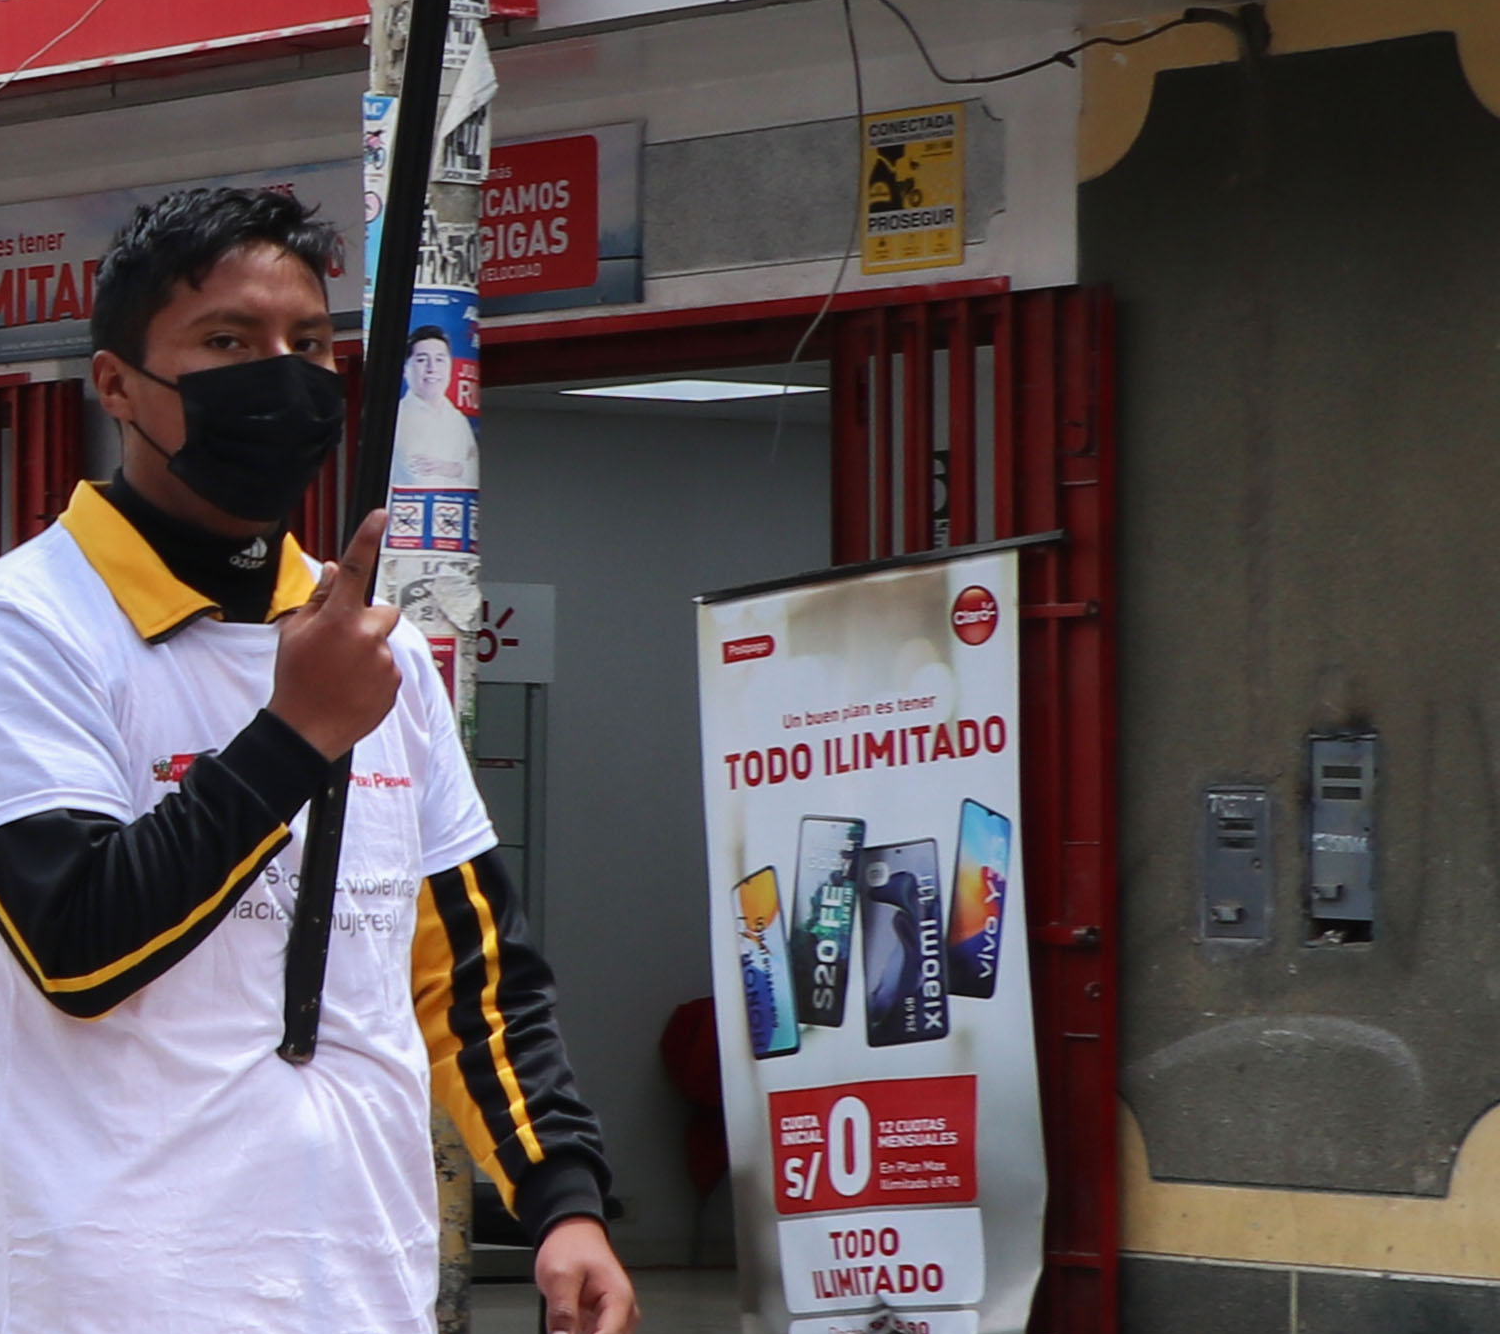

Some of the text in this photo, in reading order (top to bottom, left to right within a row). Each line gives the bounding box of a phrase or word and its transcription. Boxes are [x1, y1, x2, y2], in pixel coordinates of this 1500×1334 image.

[868, 115, 954, 138] CONECTADA
[868, 208, 955, 232] PROSEGUR
[19, 230, 65, 255] tener
[480, 217, 569, 262] GIGAS
[953, 605, 991, 627] Claro
[782, 694, 937, 730] Un buen plan es tener
[724, 715, 1008, 790] TODO ILIMITADO
[813, 885, 842, 1010] S20 FE
[976, 916, 999, 979] vivo
[877, 1131, 959, 1148] MENSUALES
[878, 1117, 947, 1133] 12 CUOTAS
[828, 1095, 872, 1196] 0
[784, 1152, 823, 1201] S/
[829, 1227, 900, 1260] TODO
[812, 1262, 944, 1300] ILIMITADO
